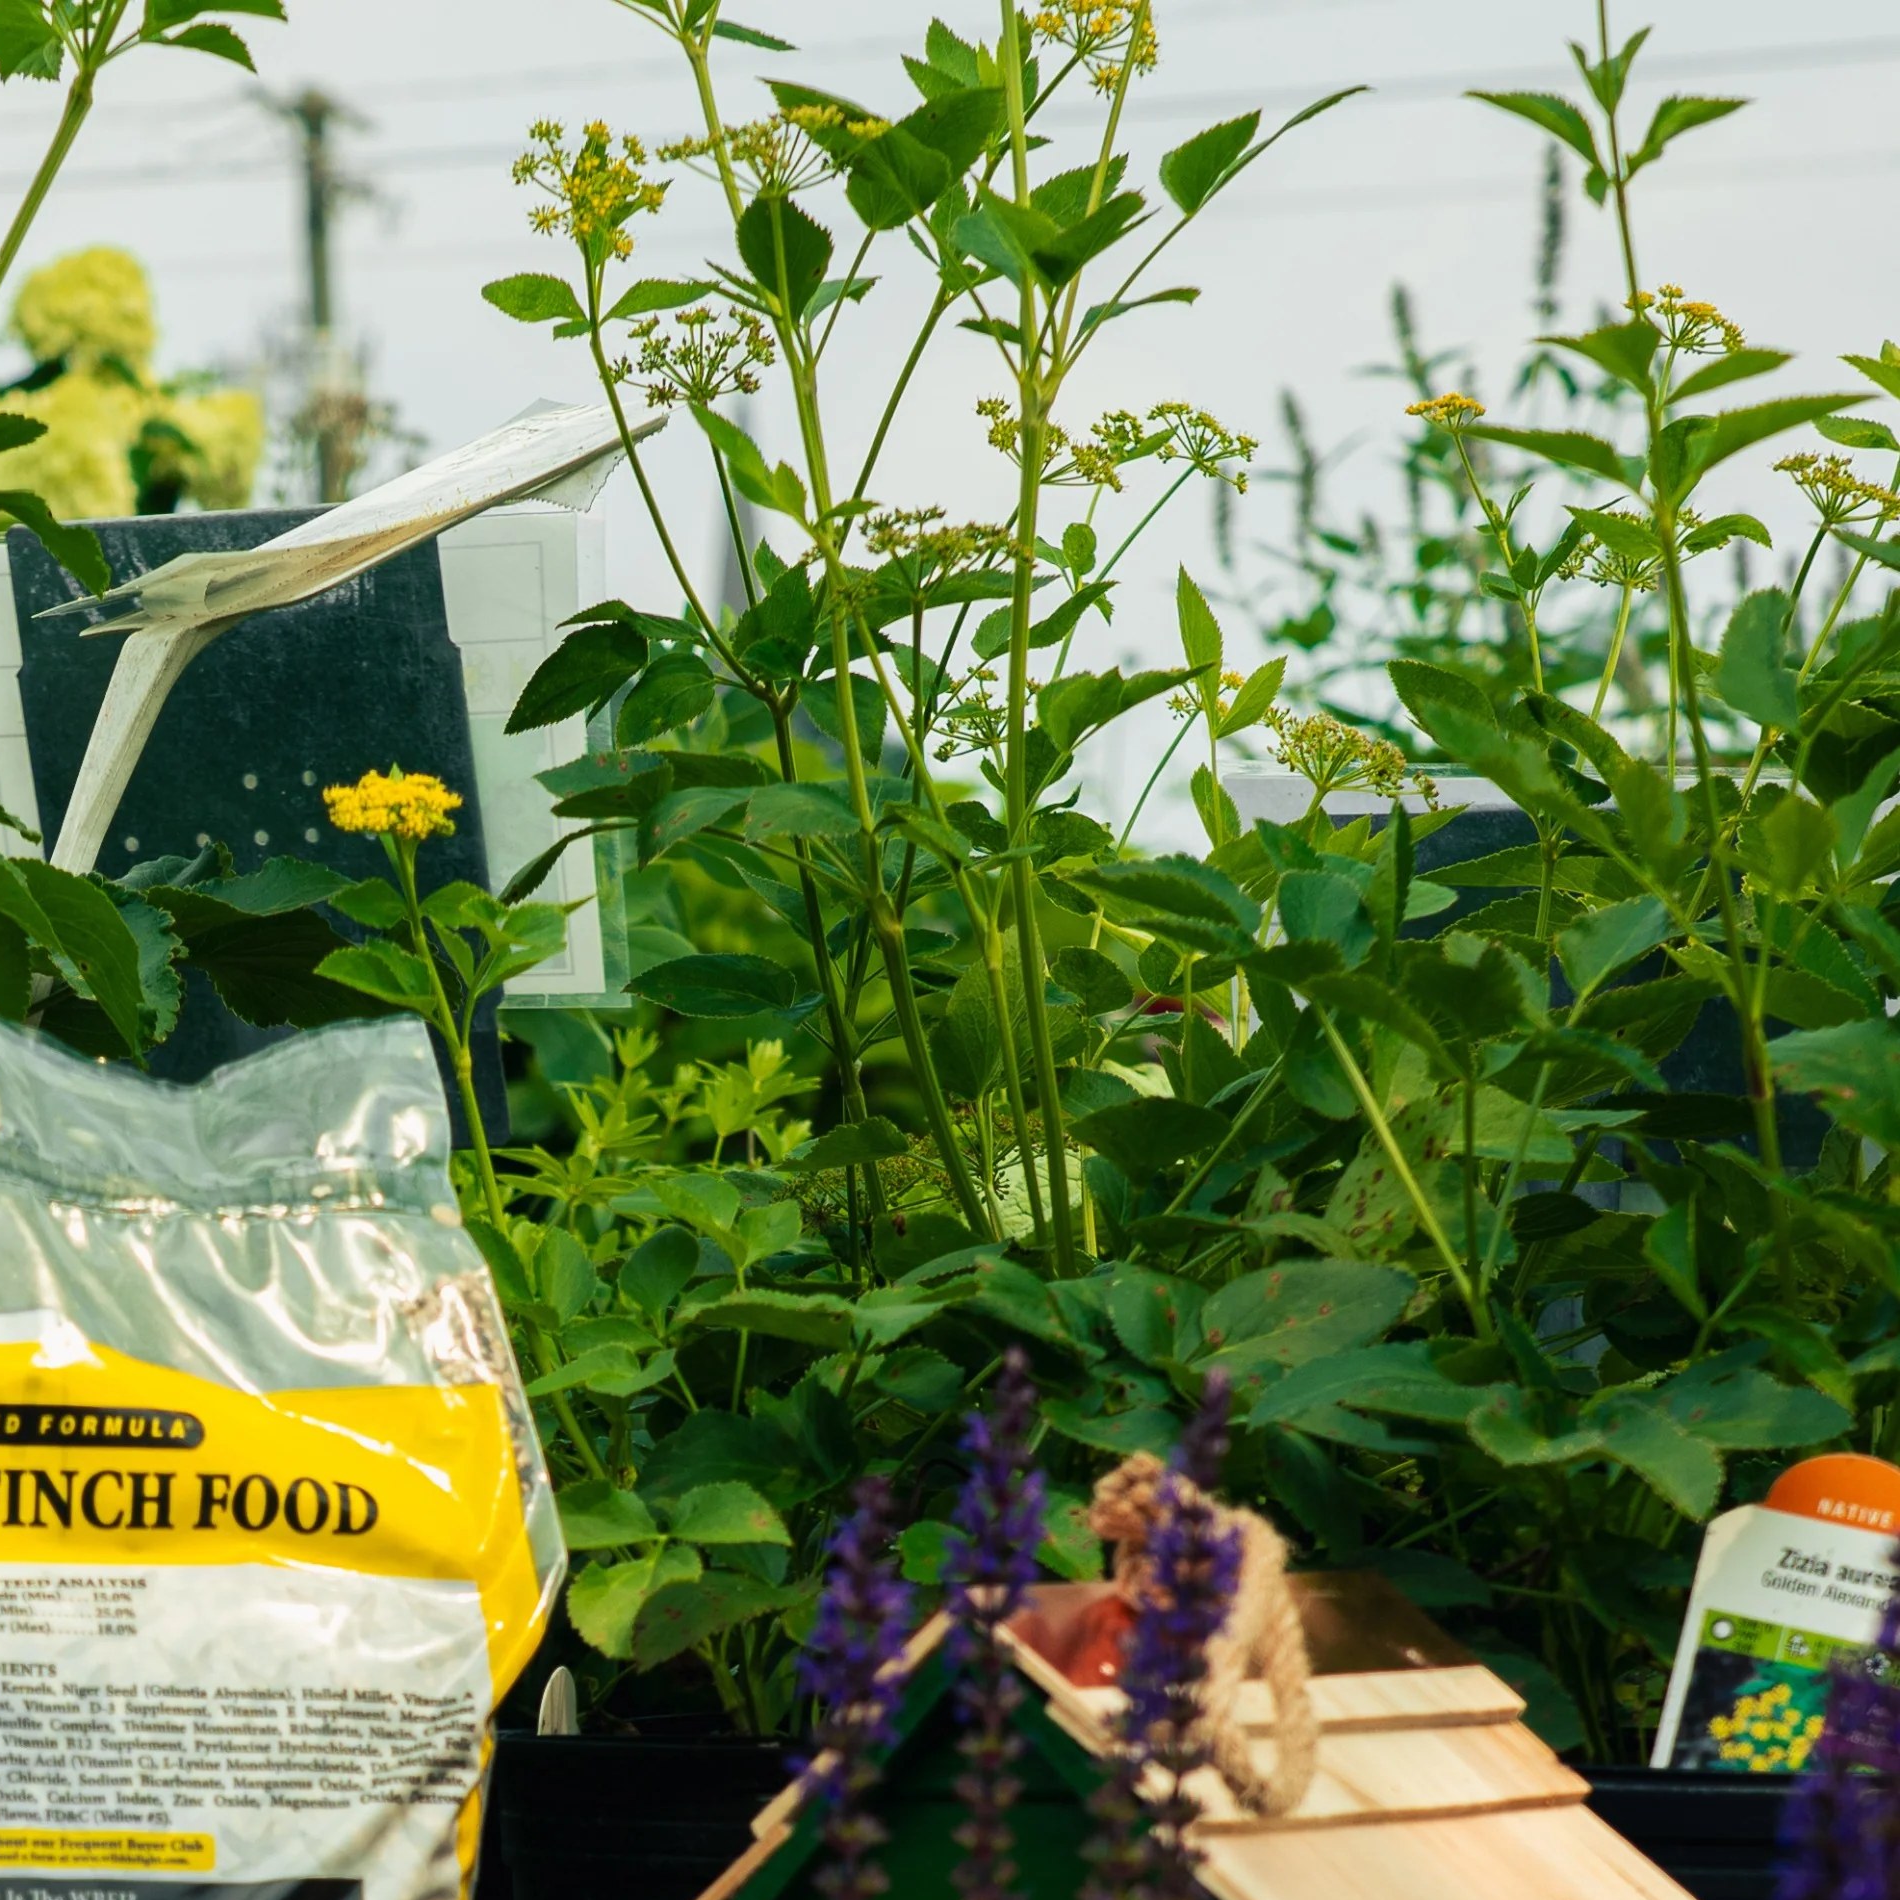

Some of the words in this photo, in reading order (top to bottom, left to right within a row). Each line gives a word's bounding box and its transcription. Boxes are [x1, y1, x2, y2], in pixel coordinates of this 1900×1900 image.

[39, 1413, 188, 1439] FORMULA
[193, 1473, 379, 1536] FOOD
[1817, 1498, 1895, 1528] NATIVE
[1776, 1546, 1831, 1577] Zizia
[58, 1578, 147, 1589] ANALYSIS
[1761, 1570, 1820, 1597] Golden
[1, 1681, 56, 1696] Kernels,
[62, 1683, 99, 1699] Niger
[106, 1684, 137, 1697] Seed
[301, 1688, 347, 1701] Hulled
[354, 1689, 397, 1705] Millet,
[23, 1700, 80, 1714] Vitamin
[89, 1703, 116, 1715] D-3
[124, 1702, 212, 1720] Supplement,
[221, 1705, 277, 1718] Vitamin
[305, 1706, 391, 1722] Supplement,
[50, 1719, 115, 1734] Complex,
[123, 1719, 186, 1734] Thiamine
[2, 1735, 58, 1749] Vitamin
[66, 1737, 92, 1750] B12
[100, 1737, 187, 1753] Supplement,
[35, 1754, 65, 1768] Acid
[71, 1755, 133, 1770] (Vitamin
[7, 1771, 71, 1786] Chloride,
[79, 1774, 133, 1787] Sodium
[319, 1778, 363, 1791] Oxide,
[47, 1791, 106, 1805] Calcium
[173, 1794, 204, 1807] Zinc
[214, 1795, 261, 1809] Oxide,
[270, 1795, 351, 1810] Magnesium
[94, 1810, 143, 1824] (Yellow
